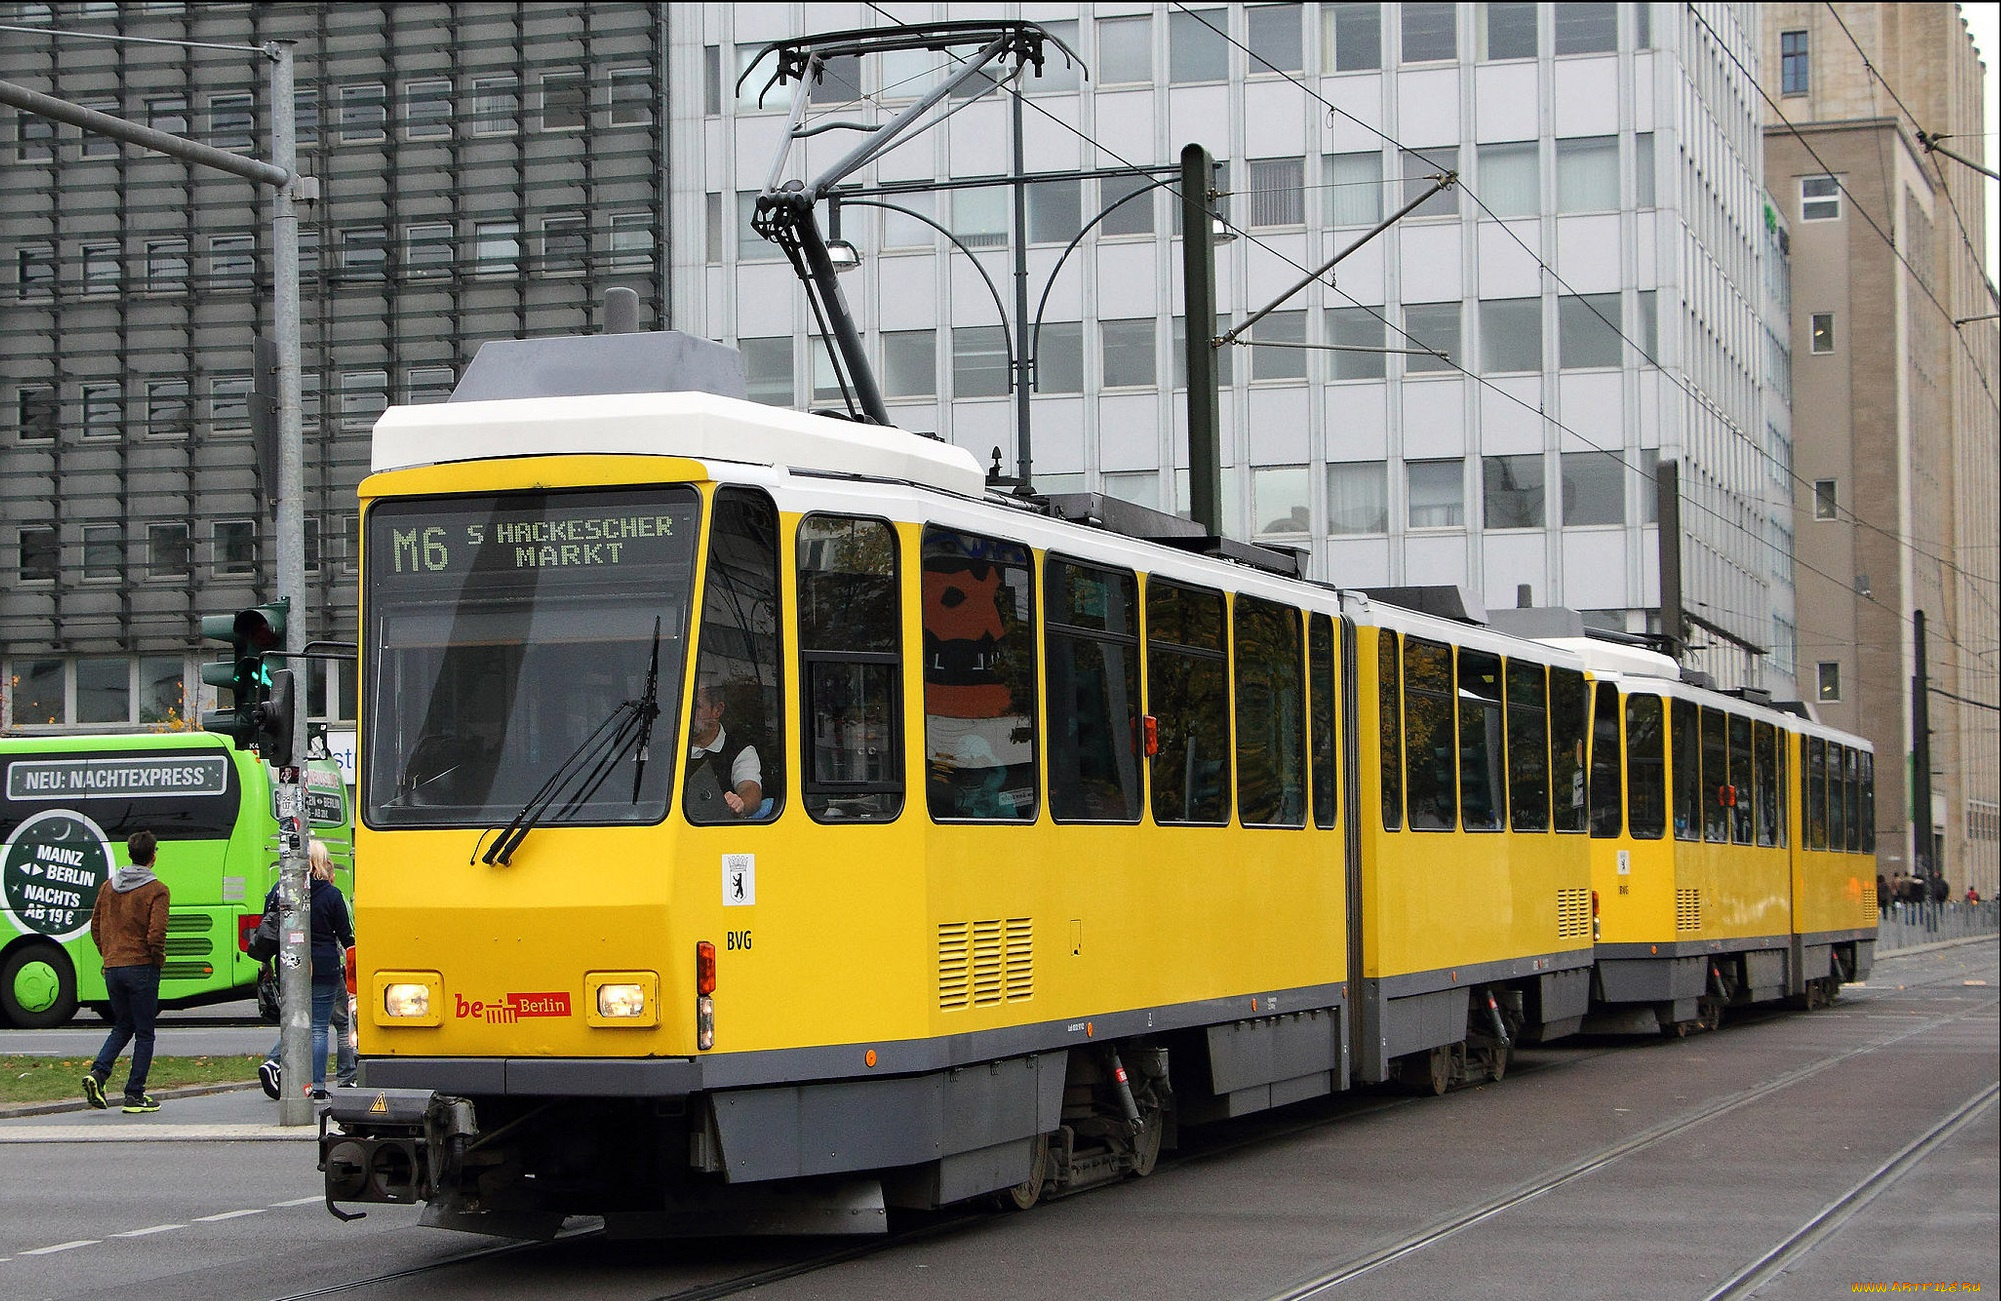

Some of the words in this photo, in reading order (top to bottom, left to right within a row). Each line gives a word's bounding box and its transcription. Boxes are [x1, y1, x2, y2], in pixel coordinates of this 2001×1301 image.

[468, 525, 485, 545] S
[497, 516, 673, 543] HACKESCHER
[392, 526, 449, 572] M6
[514, 542, 624, 568] MARKT
[26, 770, 67, 790] NEU:
[69, 767, 205, 788] NACHTEXPRESS
[36, 844, 84, 867] MAINZ
[46, 864, 95, 887] BERLIN
[23, 884, 81, 908] NACHTS
[24, 903, 46, 920] AB
[726, 930, 752, 951] BVG
[454, 994, 484, 1018] be
[518, 998, 566, 1014] Berlin
